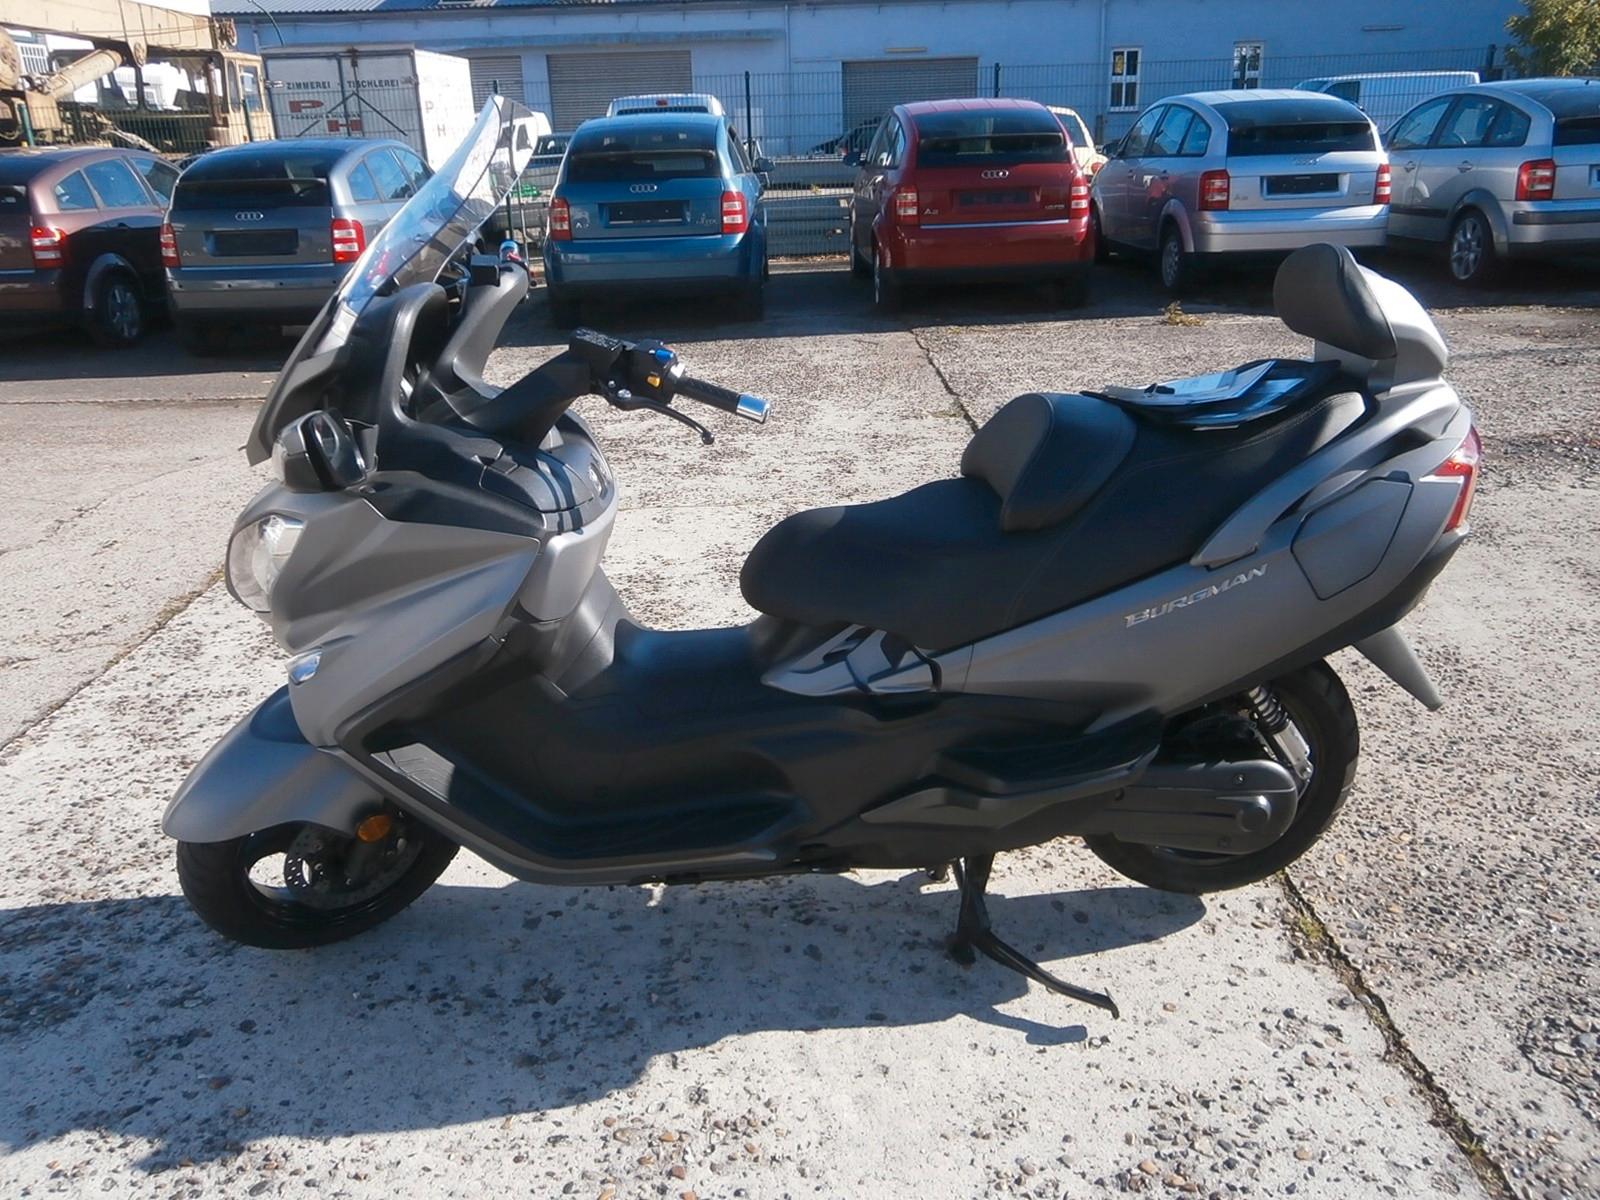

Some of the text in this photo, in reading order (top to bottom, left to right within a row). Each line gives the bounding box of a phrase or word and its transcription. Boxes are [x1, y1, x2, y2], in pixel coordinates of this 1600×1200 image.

[286, 81, 331, 90] ZIMMEREI
[347, 79, 399, 89] TISCHLEREI
[1123, 563, 1268, 629] BURGMAN
